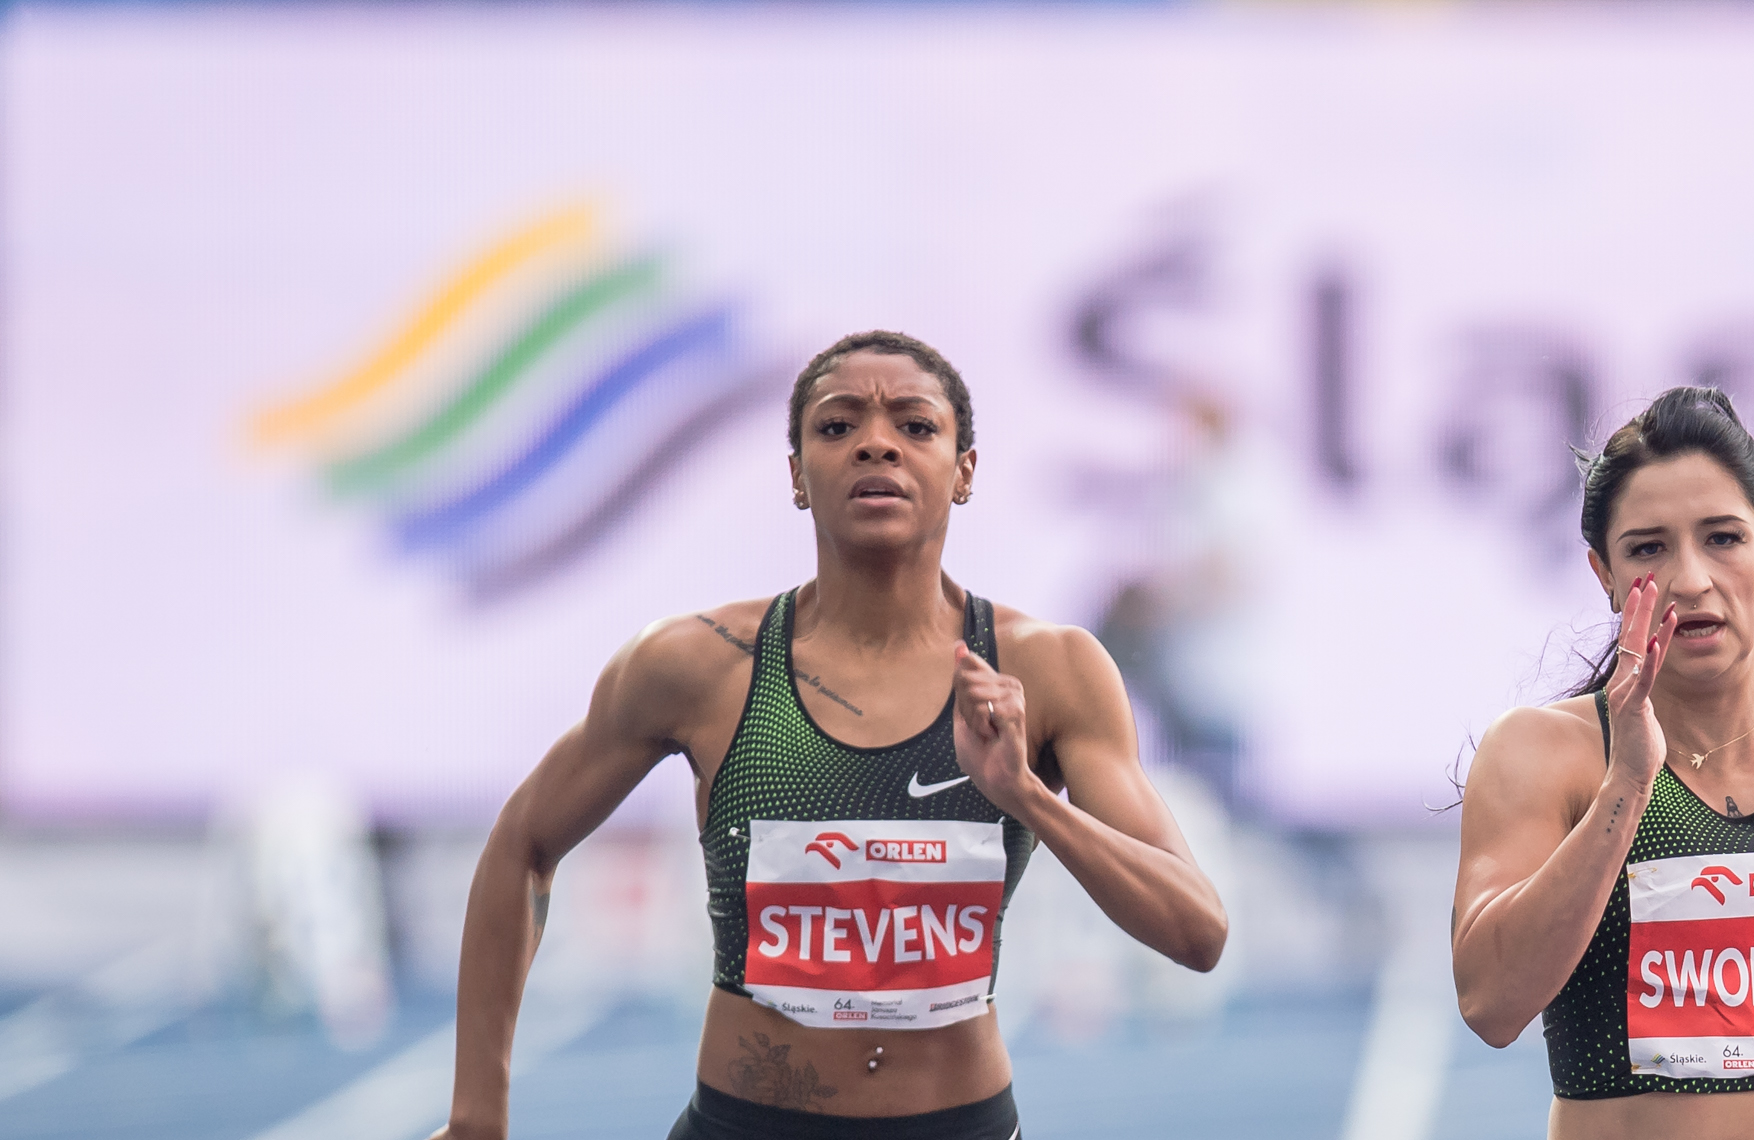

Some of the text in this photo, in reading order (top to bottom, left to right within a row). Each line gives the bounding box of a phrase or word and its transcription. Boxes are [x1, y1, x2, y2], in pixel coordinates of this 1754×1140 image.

[869, 842, 943, 860] ORLEN
[758, 904, 988, 963] STEVENS
[1669, 1052, 1707, 1066] Śląskie.
